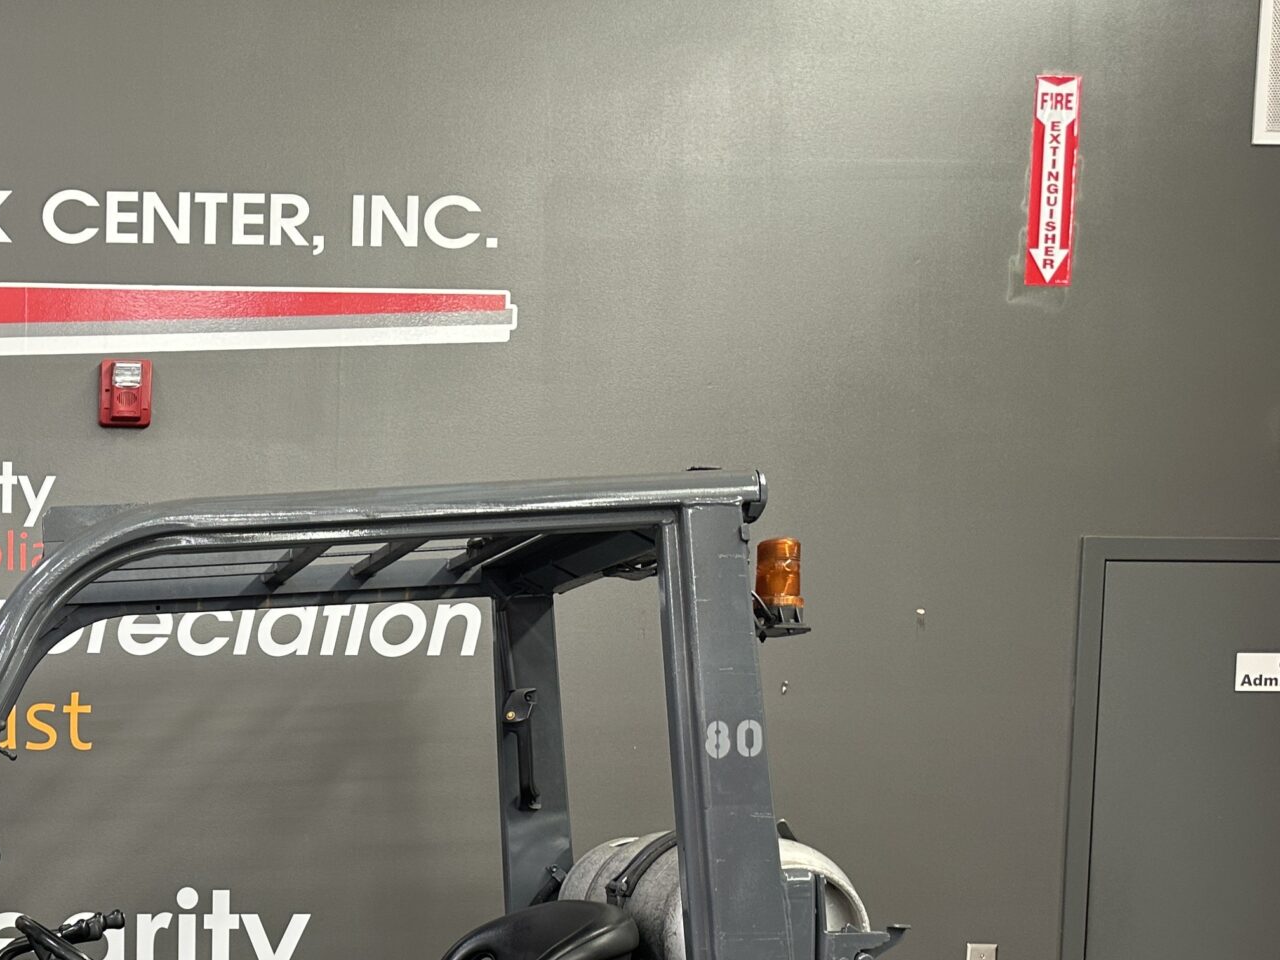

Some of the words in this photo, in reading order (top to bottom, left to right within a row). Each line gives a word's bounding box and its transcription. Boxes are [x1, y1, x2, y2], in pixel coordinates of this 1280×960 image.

[1040, 92, 1074, 111] FIRE
[1041, 121, 1062, 270] EXTINGUISHER
[41, 188, 325, 256] CENTER,
[351, 194, 499, 250] INC.
[1240, 674, 1279, 687] Adm
[704, 719, 763, 760] 80
